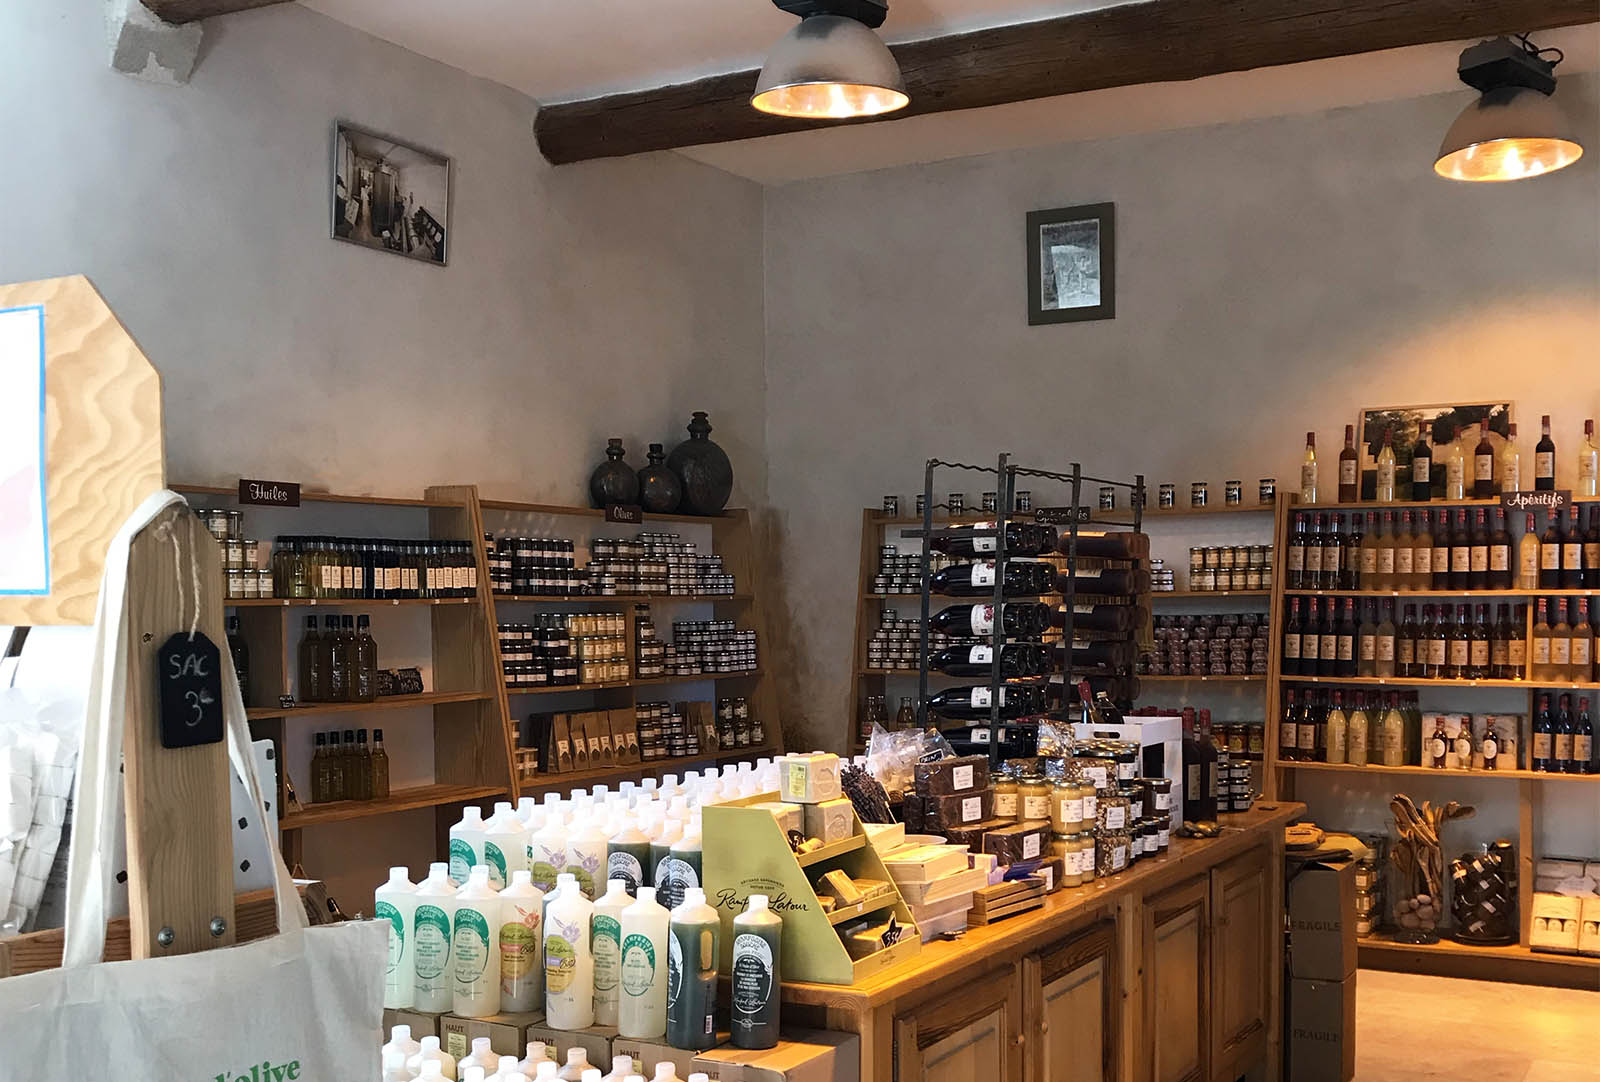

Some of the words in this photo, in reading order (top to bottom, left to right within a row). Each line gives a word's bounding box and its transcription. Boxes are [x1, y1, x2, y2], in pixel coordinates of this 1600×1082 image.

[249, 483, 288, 501] Huiles
[1507, 492, 1563, 510] Apéritifs
[169, 653, 208, 679] SAC
[767, 892, 808, 913] Latour
[445, 1023, 465, 1033] HAUT
